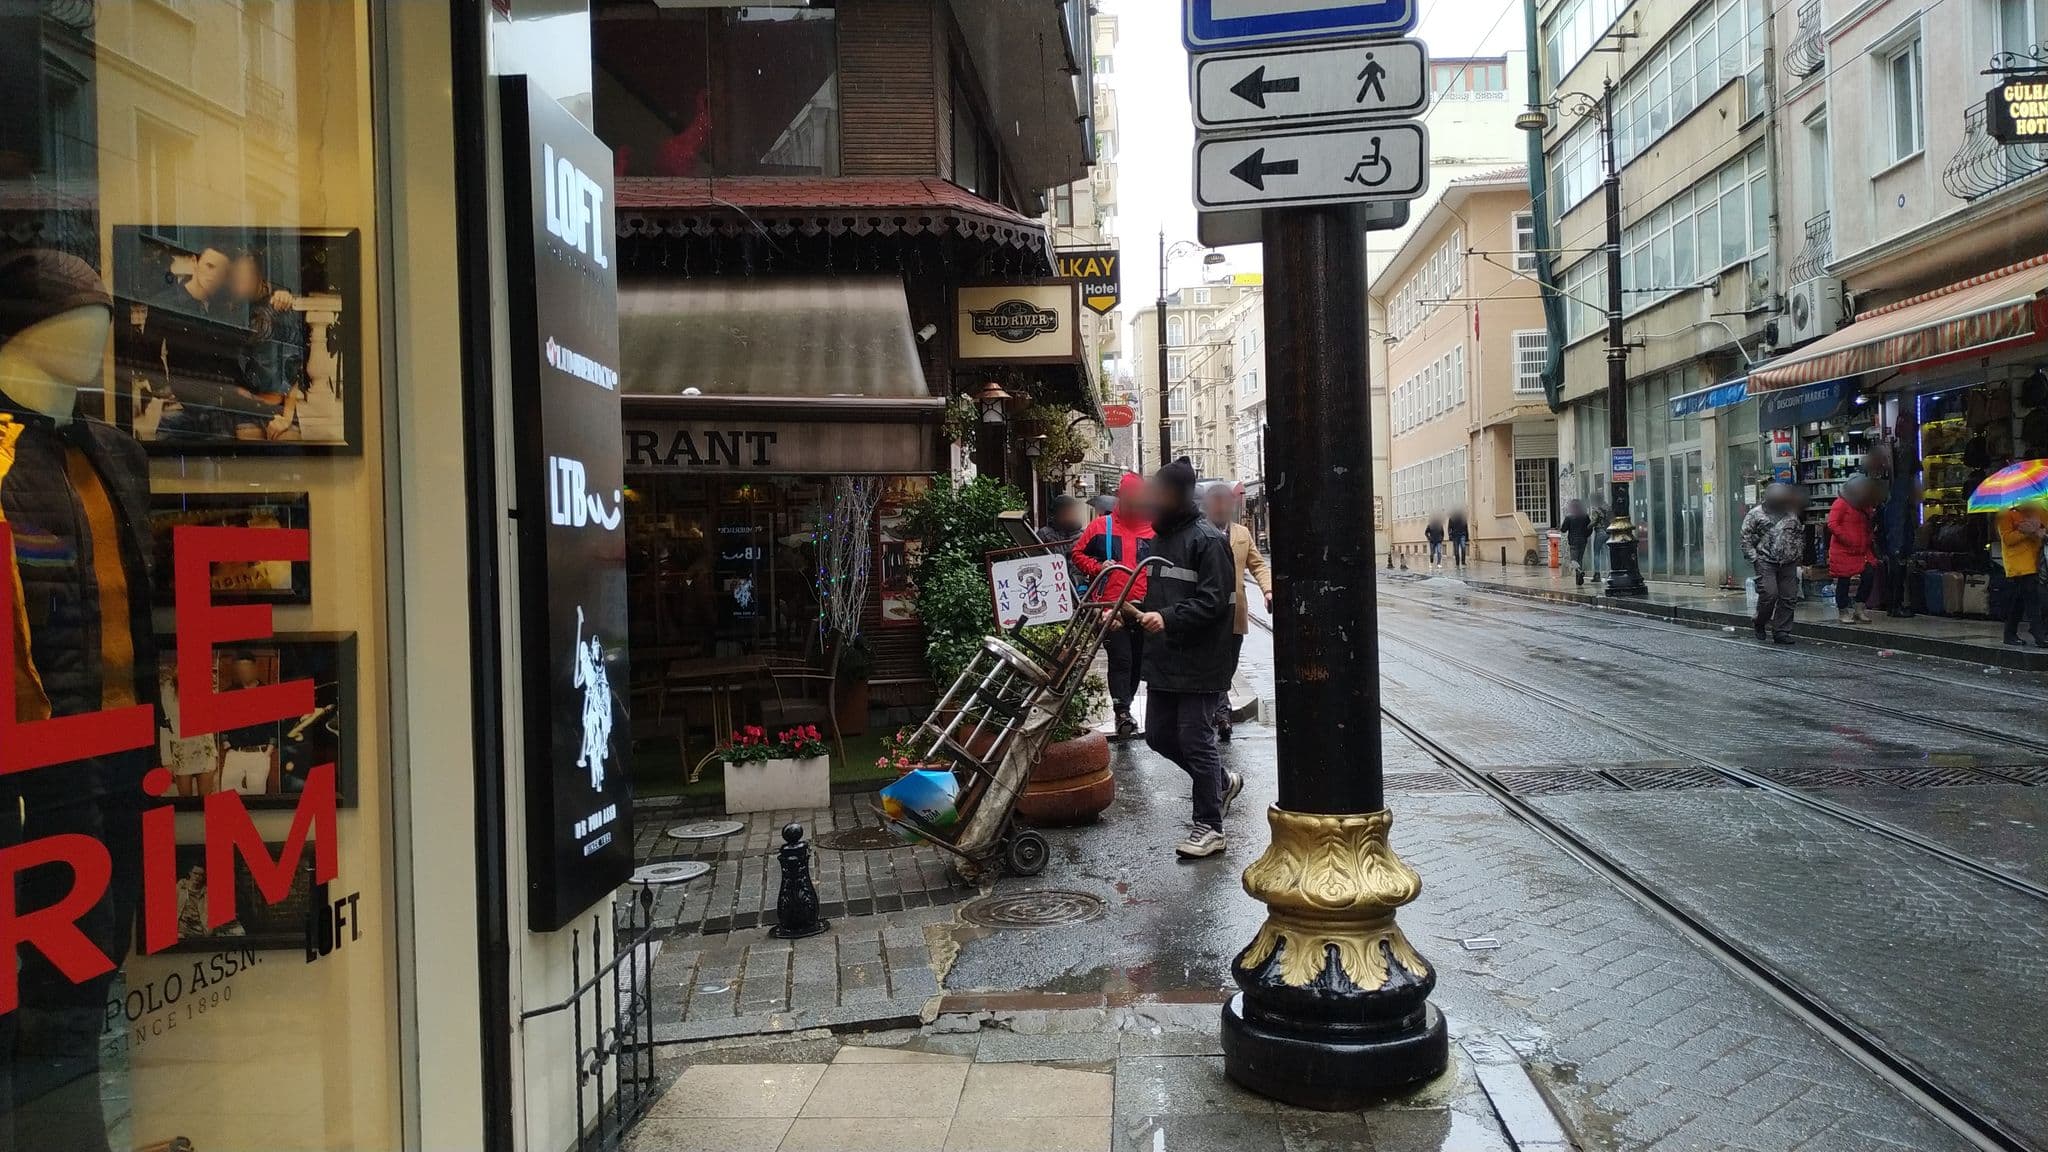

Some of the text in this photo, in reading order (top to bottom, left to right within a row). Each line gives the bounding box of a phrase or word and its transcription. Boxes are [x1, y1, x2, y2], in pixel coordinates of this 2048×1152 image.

[2016, 119, 2048, 135] HOT
[1085, 283, 1118, 295] Hotel
[985, 314, 1049, 327] RED RIVER
[1777, 387, 1830, 410] DISCOUNT MARKET
[550, 455, 587, 528] LTB
[997, 579, 1010, 612] MAN
[1051, 560, 1069, 614] WOMAN
[304, 892, 361, 964] LOFT
[103, 972, 183, 1034] POLO
[106, 985, 233, 1058] SINCE 1890
